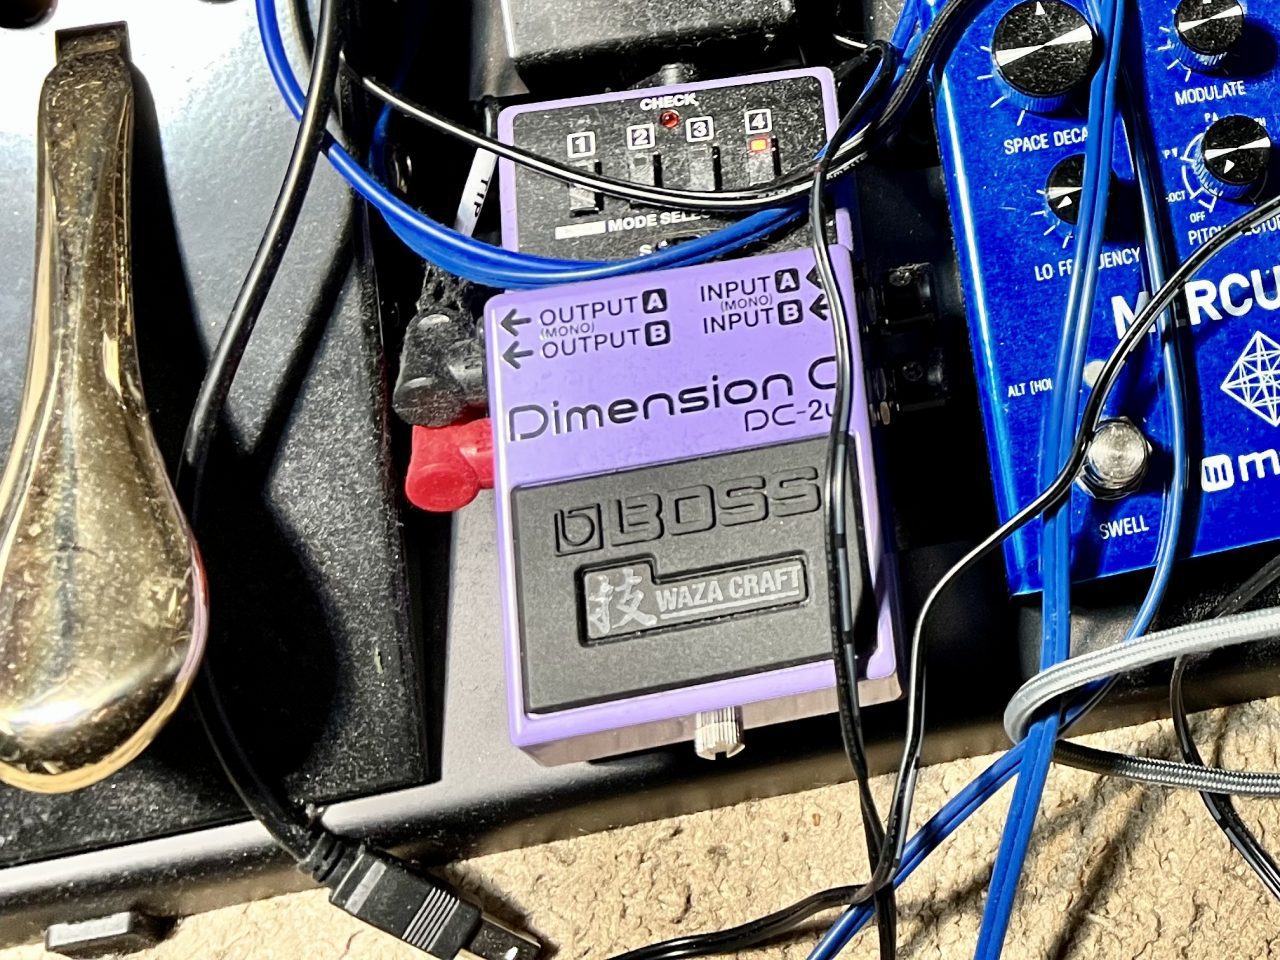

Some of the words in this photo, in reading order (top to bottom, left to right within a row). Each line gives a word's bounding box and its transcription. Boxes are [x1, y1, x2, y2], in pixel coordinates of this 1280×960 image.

[640, 92, 699, 112] CHECK
[1175, 80, 1246, 106] MODULATE
[1004, 133, 1050, 156] SPACE
[1053, 126, 1088, 148] DECA
[473, 177, 491, 218] TIP
[608, 213, 658, 233] MODE
[1189, 211, 1206, 223] OFF
[700, 275, 771, 303] INPUT
[776, 270, 798, 292] A
[1034, 263, 1053, 282] LO
[539, 295, 639, 327] OUTPUT
[644, 291, 666, 312] A
[703, 307, 774, 334] INPUT
[779, 301, 801, 324] B
[720, 294, 773, 313] (MONO)
[540, 321, 595, 340] (MONO)
[541, 328, 641, 359] OUTPUT
[647, 322, 668, 344] B
[1007, 381, 1028, 398] ALT
[508, 374, 794, 443] Dimension
[609, 465, 823, 548] BOSS
[1100, 514, 1149, 541] SWELL
[655, 581, 724, 613] WAZA
[728, 564, 802, 599] CRAFT
